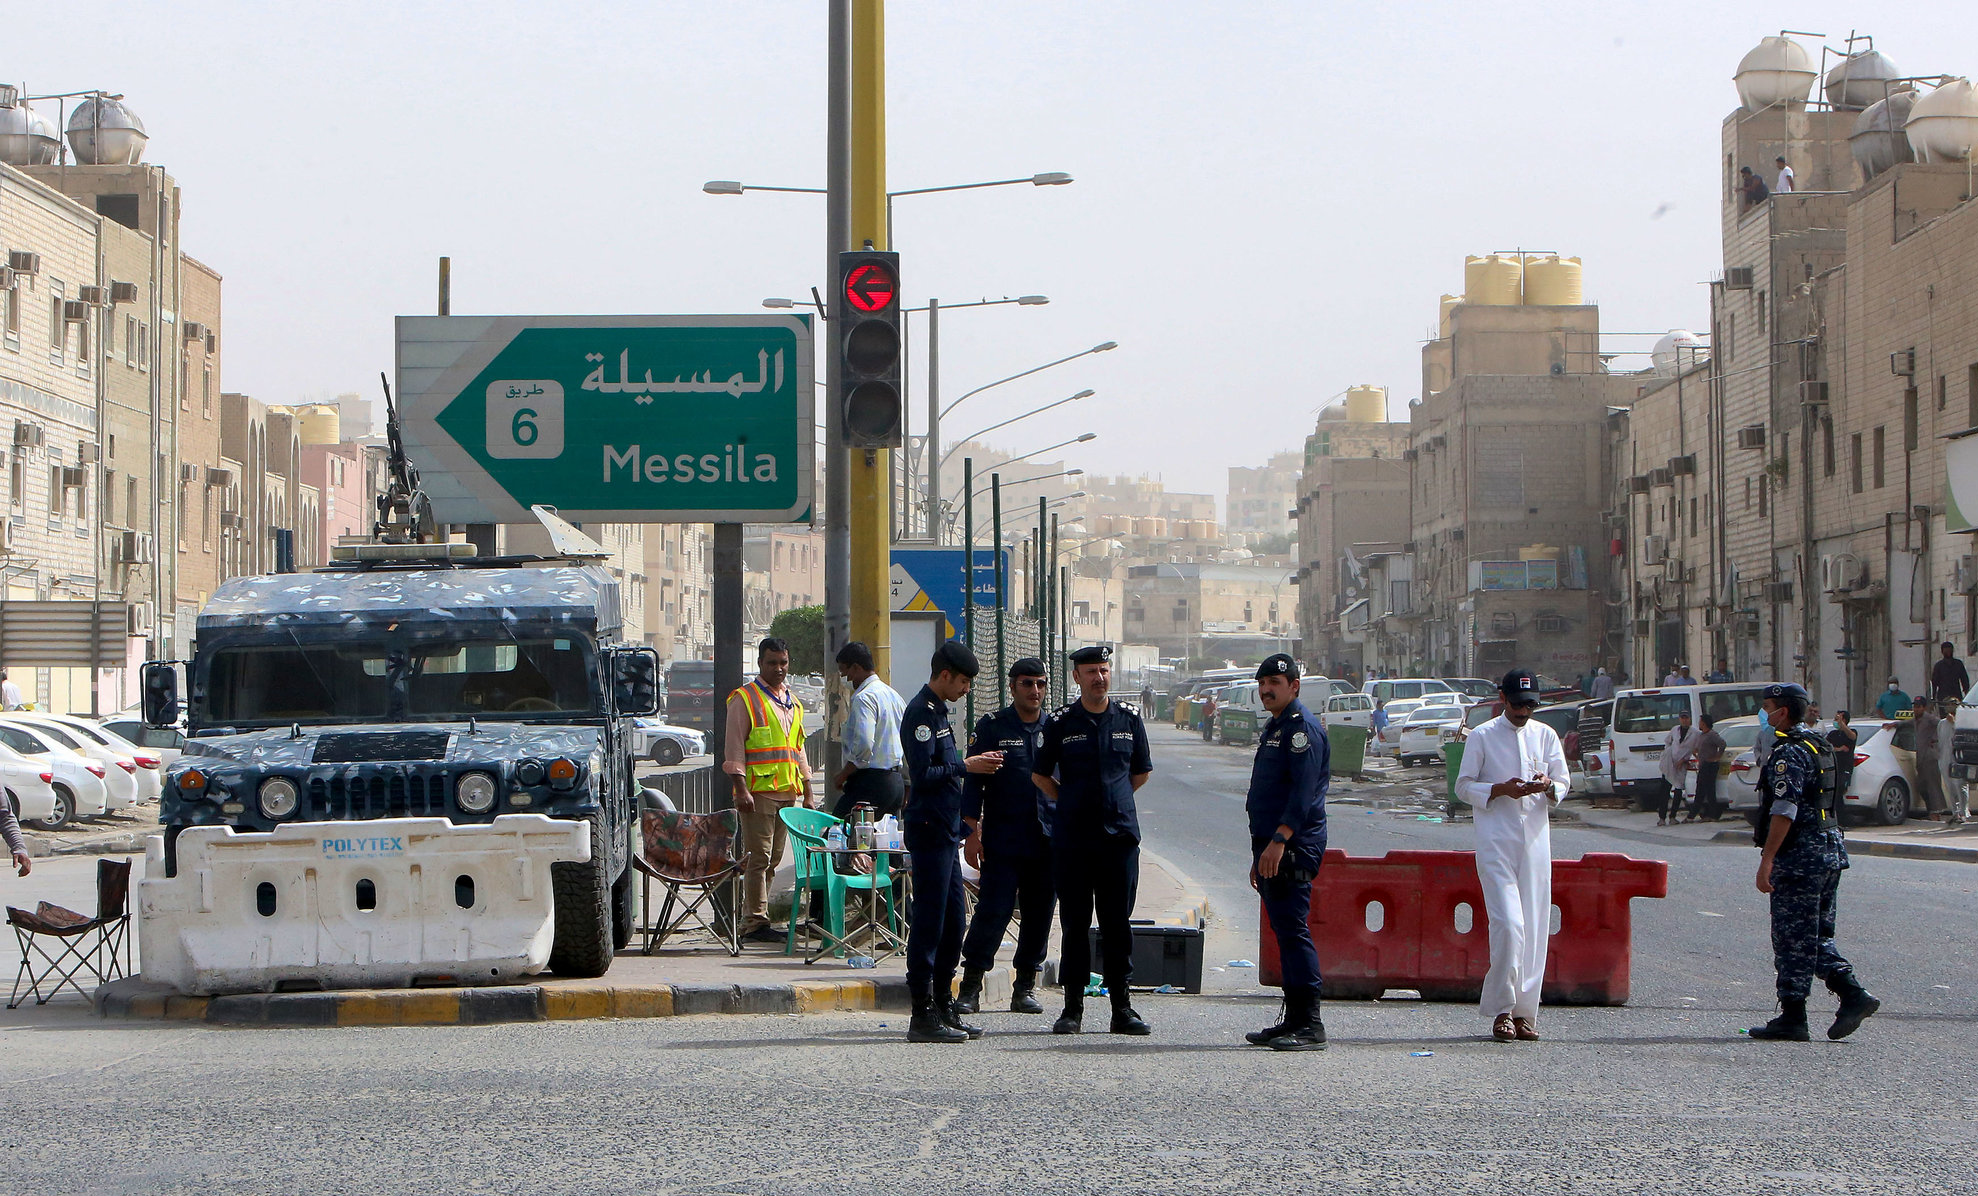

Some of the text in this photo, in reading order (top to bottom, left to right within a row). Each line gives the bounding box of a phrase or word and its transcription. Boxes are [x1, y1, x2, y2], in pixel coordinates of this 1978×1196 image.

[505, 383, 545, 399] طريق
[581, 347, 785, 406] المسيلة
[511, 407, 539, 447] 6
[603, 443, 778, 483] Messila
[322, 836, 403, 852] POLYTEX
